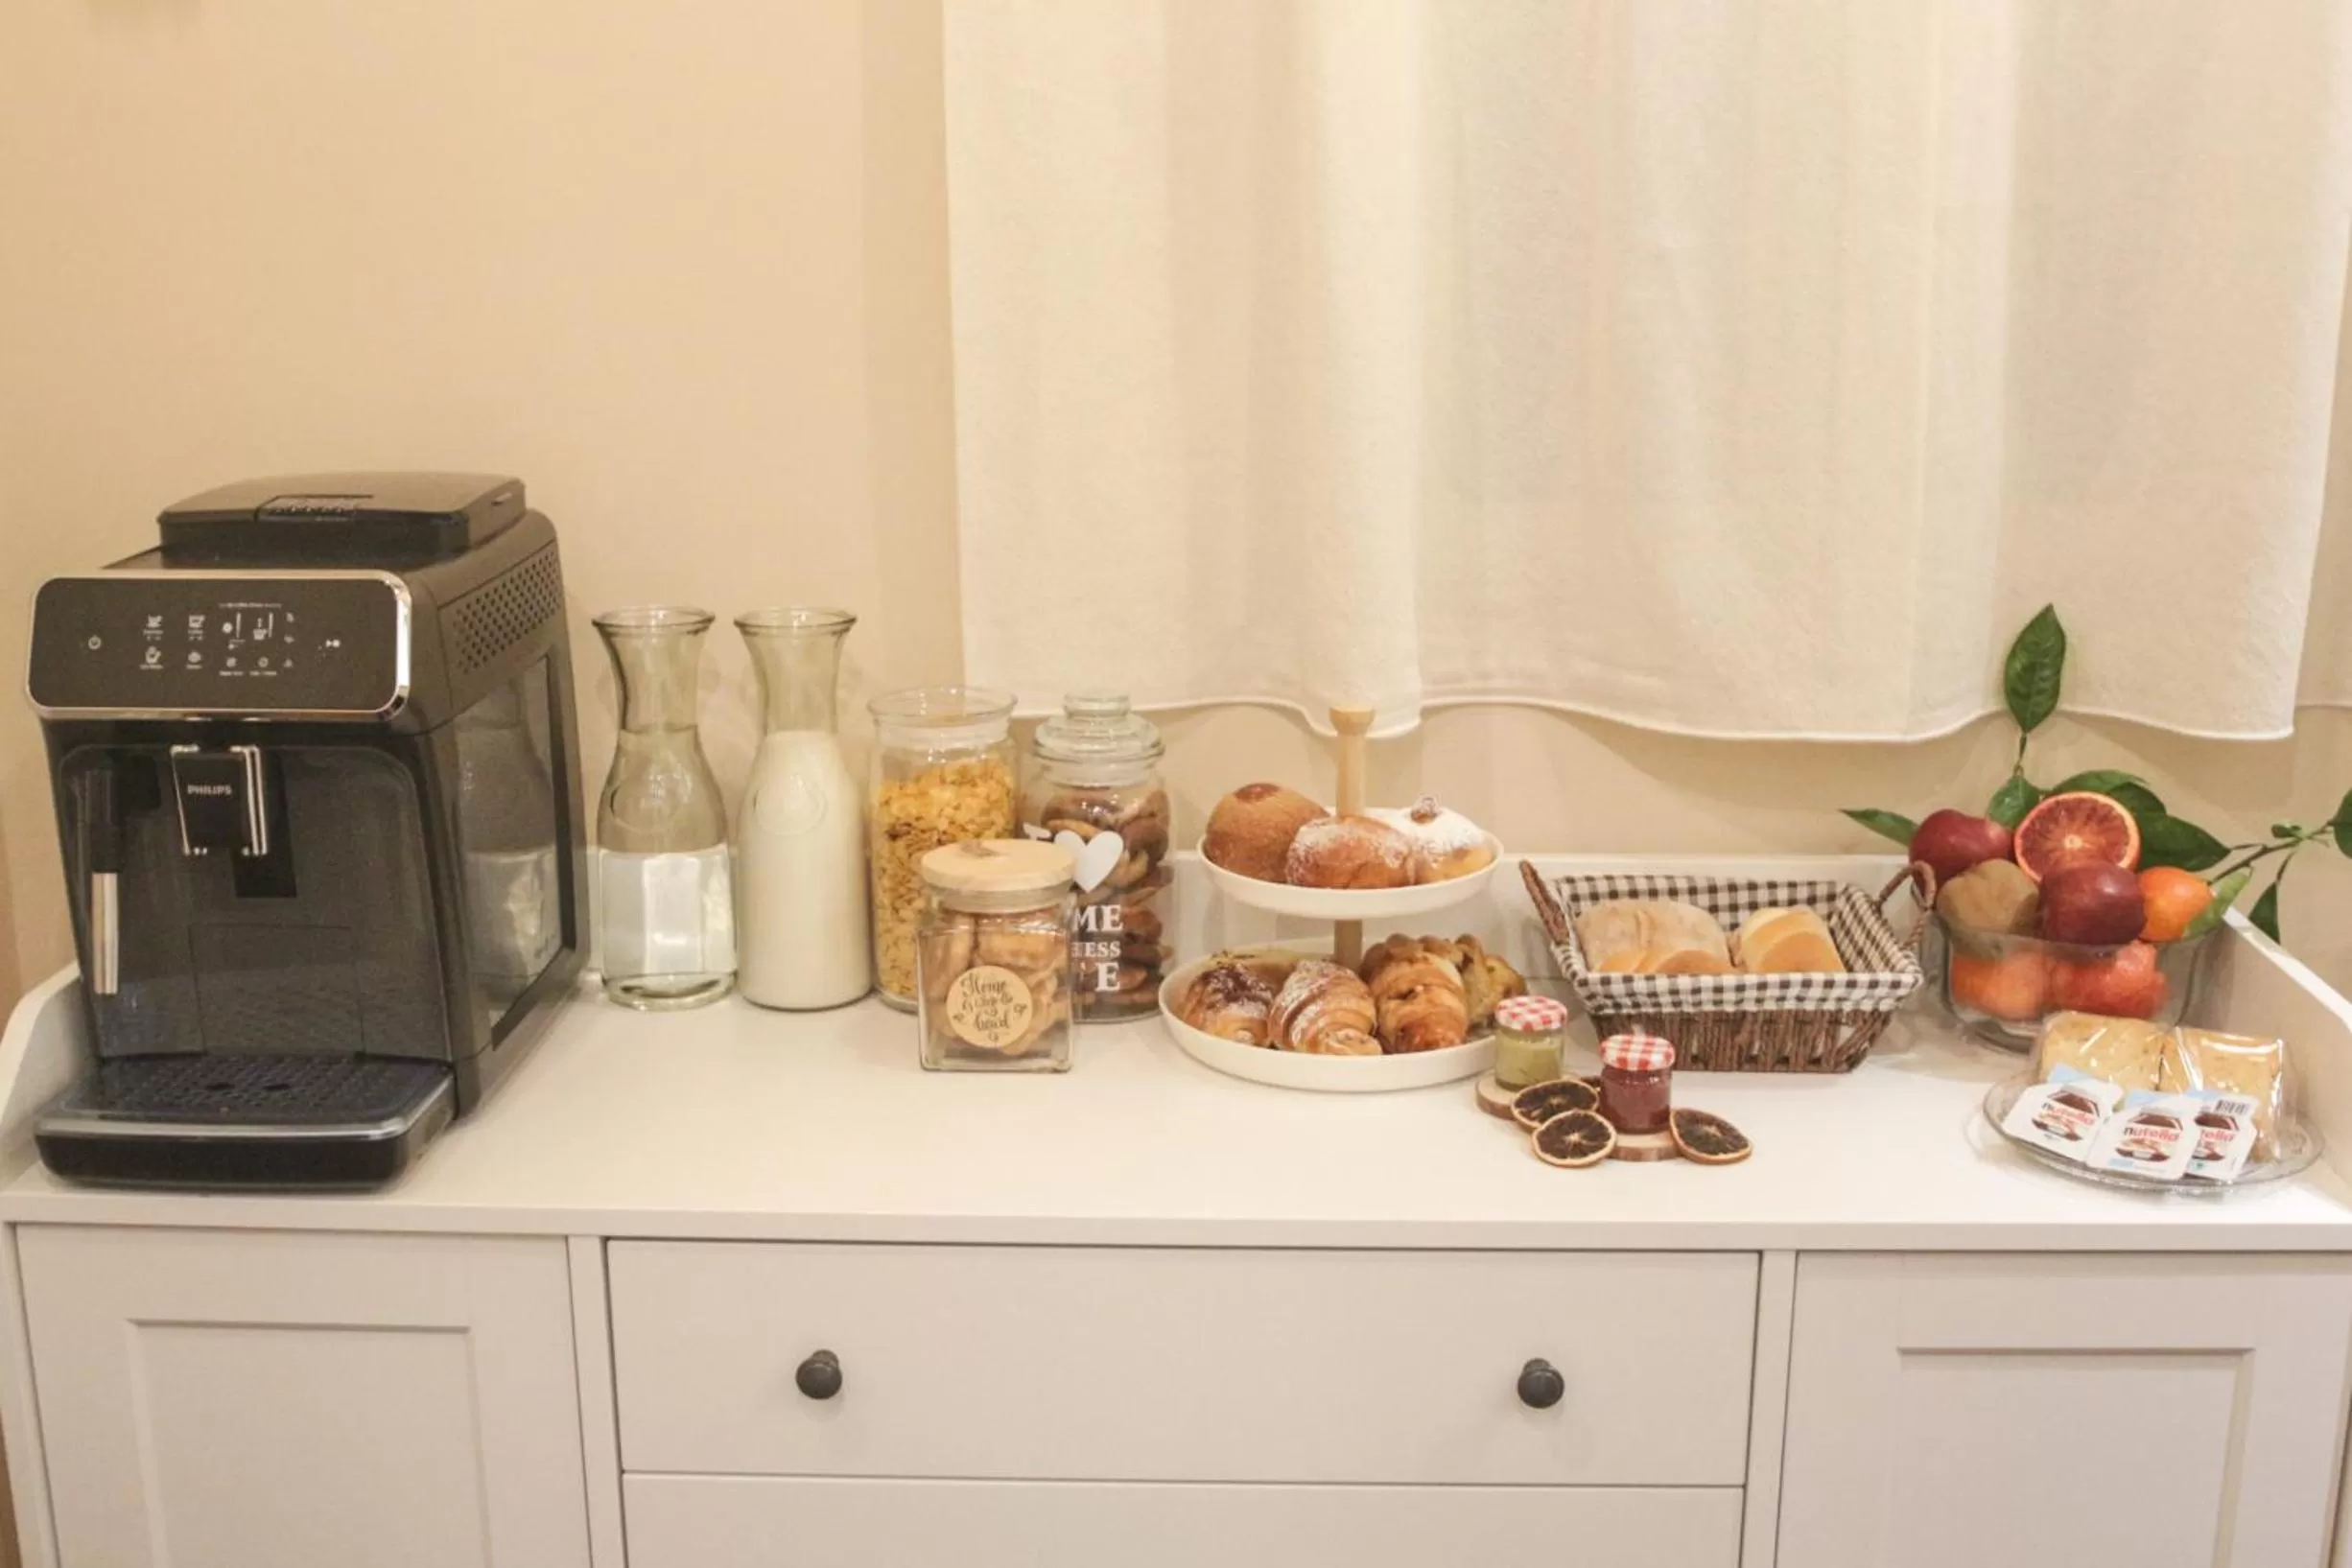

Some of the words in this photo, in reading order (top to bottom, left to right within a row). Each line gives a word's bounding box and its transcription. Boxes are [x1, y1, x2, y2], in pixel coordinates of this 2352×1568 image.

[187, 784, 232, 795] PHILIPS
[1072, 904, 1124, 932] ME
[2123, 1126, 2180, 1142] nutella
[2201, 1129, 2235, 1142] tella
